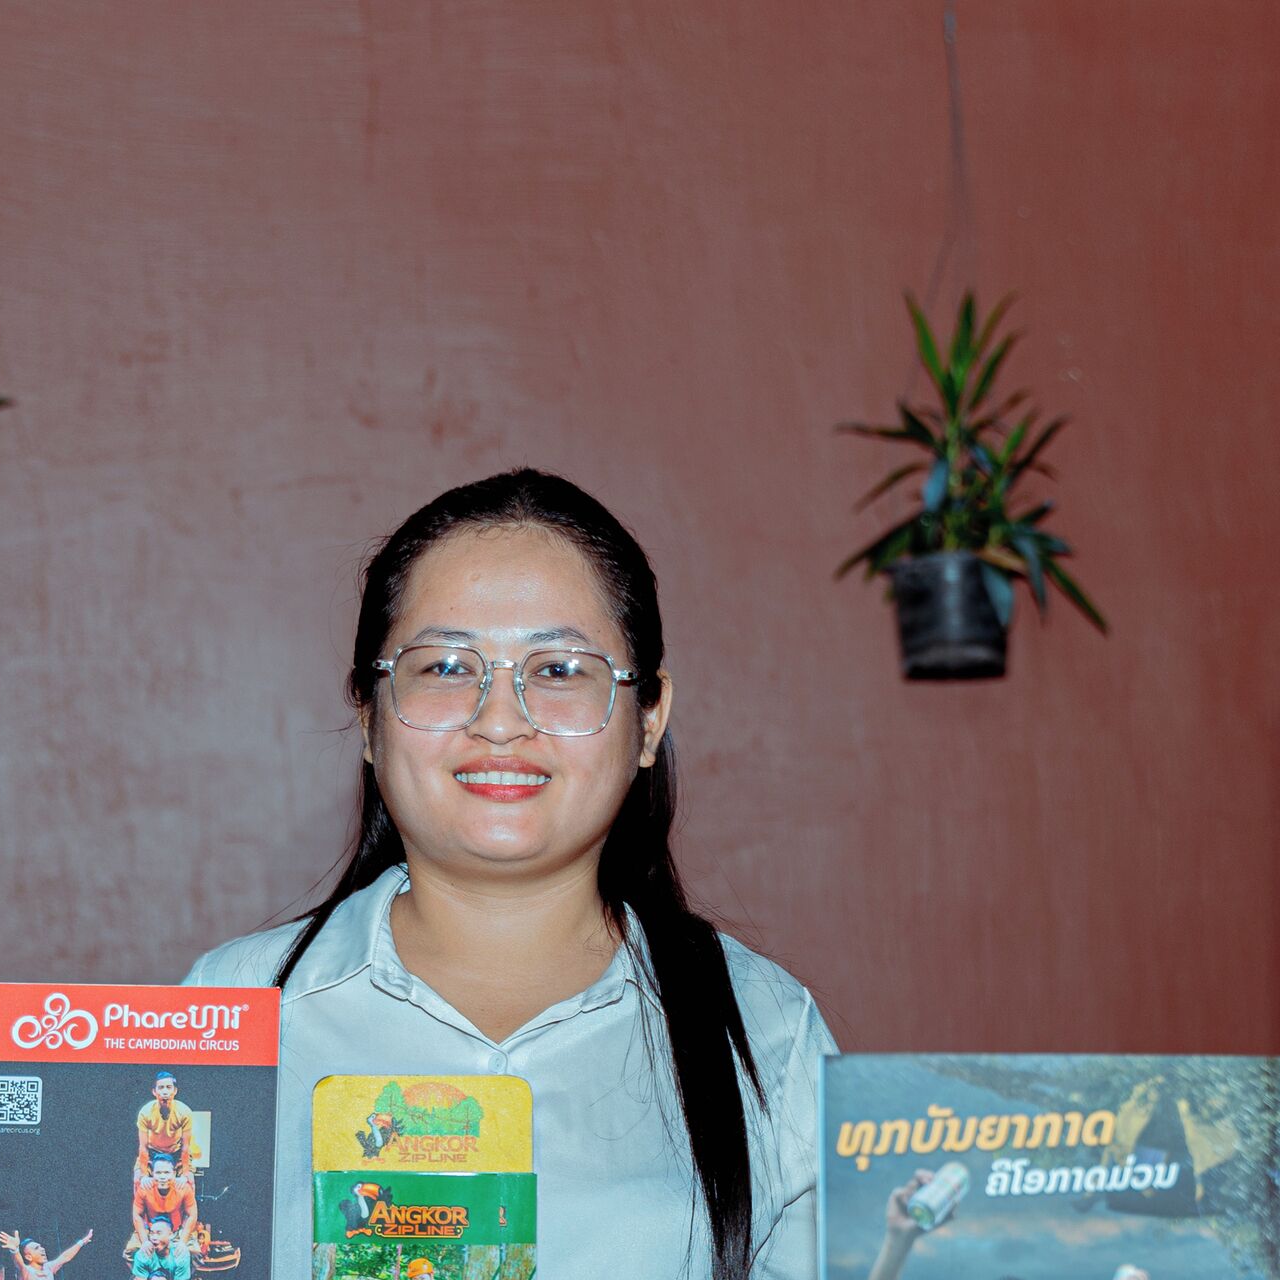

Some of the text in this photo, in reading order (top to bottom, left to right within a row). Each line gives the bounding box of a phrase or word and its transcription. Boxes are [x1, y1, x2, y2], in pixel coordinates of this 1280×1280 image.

[104, 1038, 240, 1051] THE CAMBODIAN CIRCUS
[386, 1132, 480, 1153] ANGKOR
[368, 1200, 469, 1226] ANGKOR
